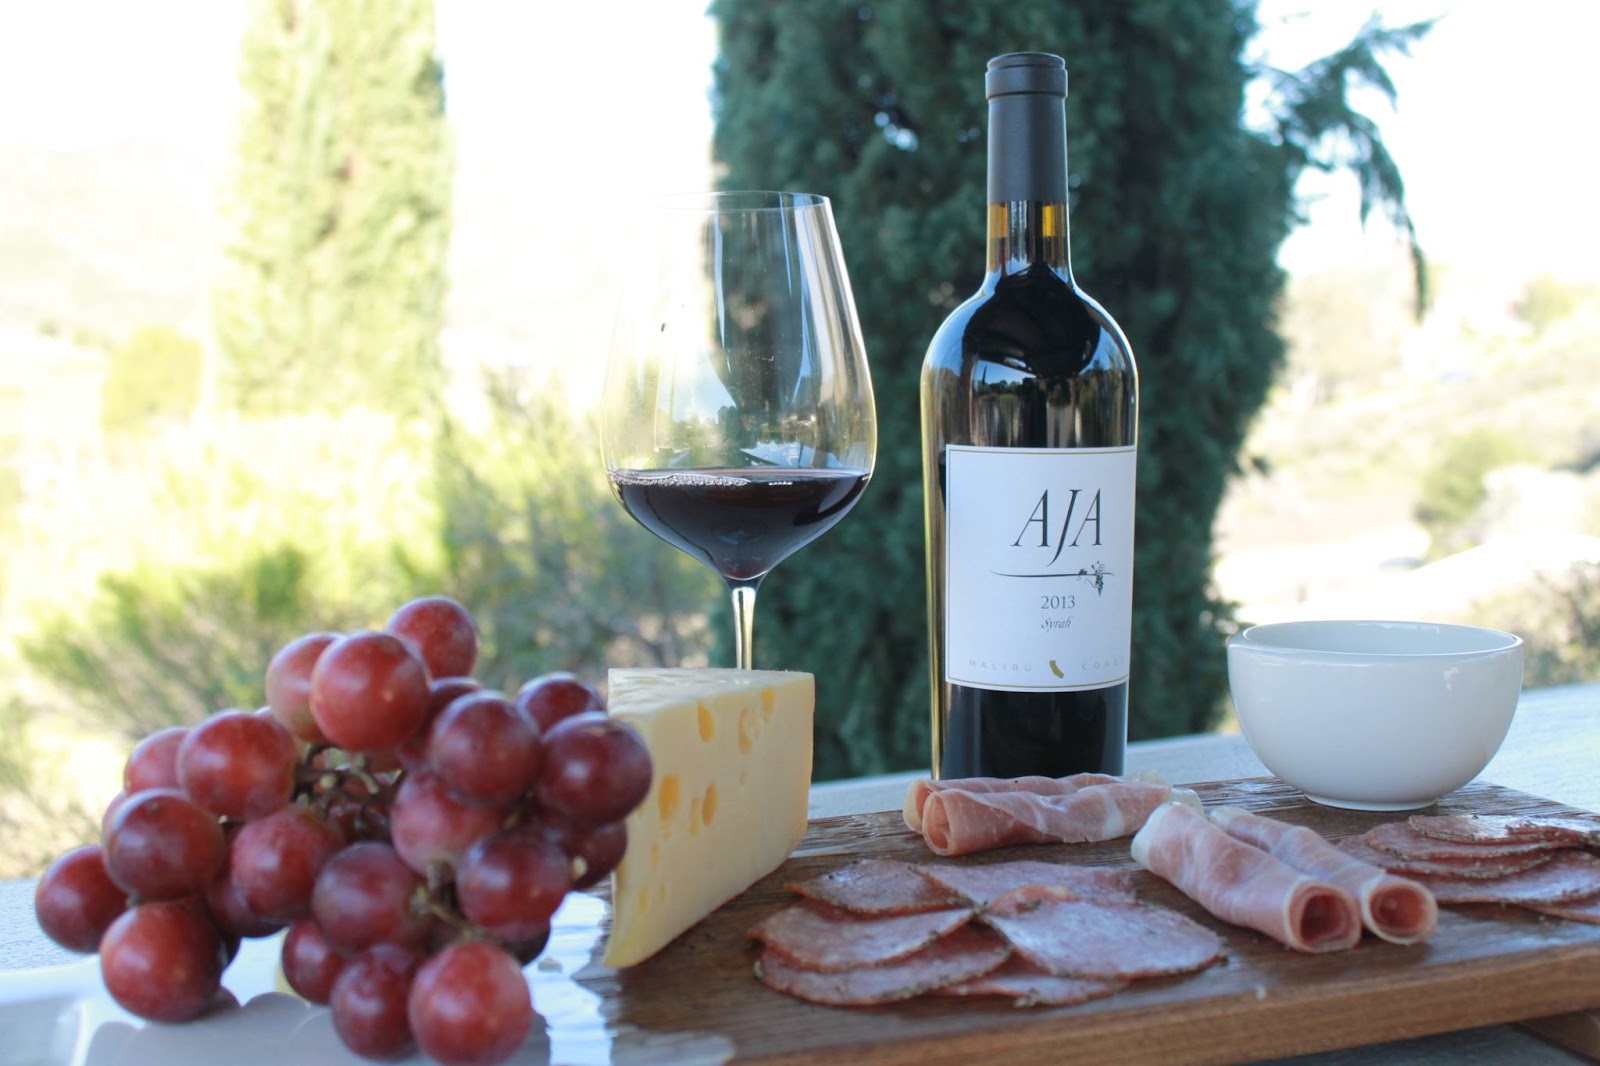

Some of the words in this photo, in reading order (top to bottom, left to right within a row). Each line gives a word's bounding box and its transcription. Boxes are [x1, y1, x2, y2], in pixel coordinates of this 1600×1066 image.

[1011, 488, 1102, 567] AJA
[1041, 595, 1076, 610] 2013
[1040, 617, 1072, 632] Syrah
[969, 660, 1031, 672] MALIBU
